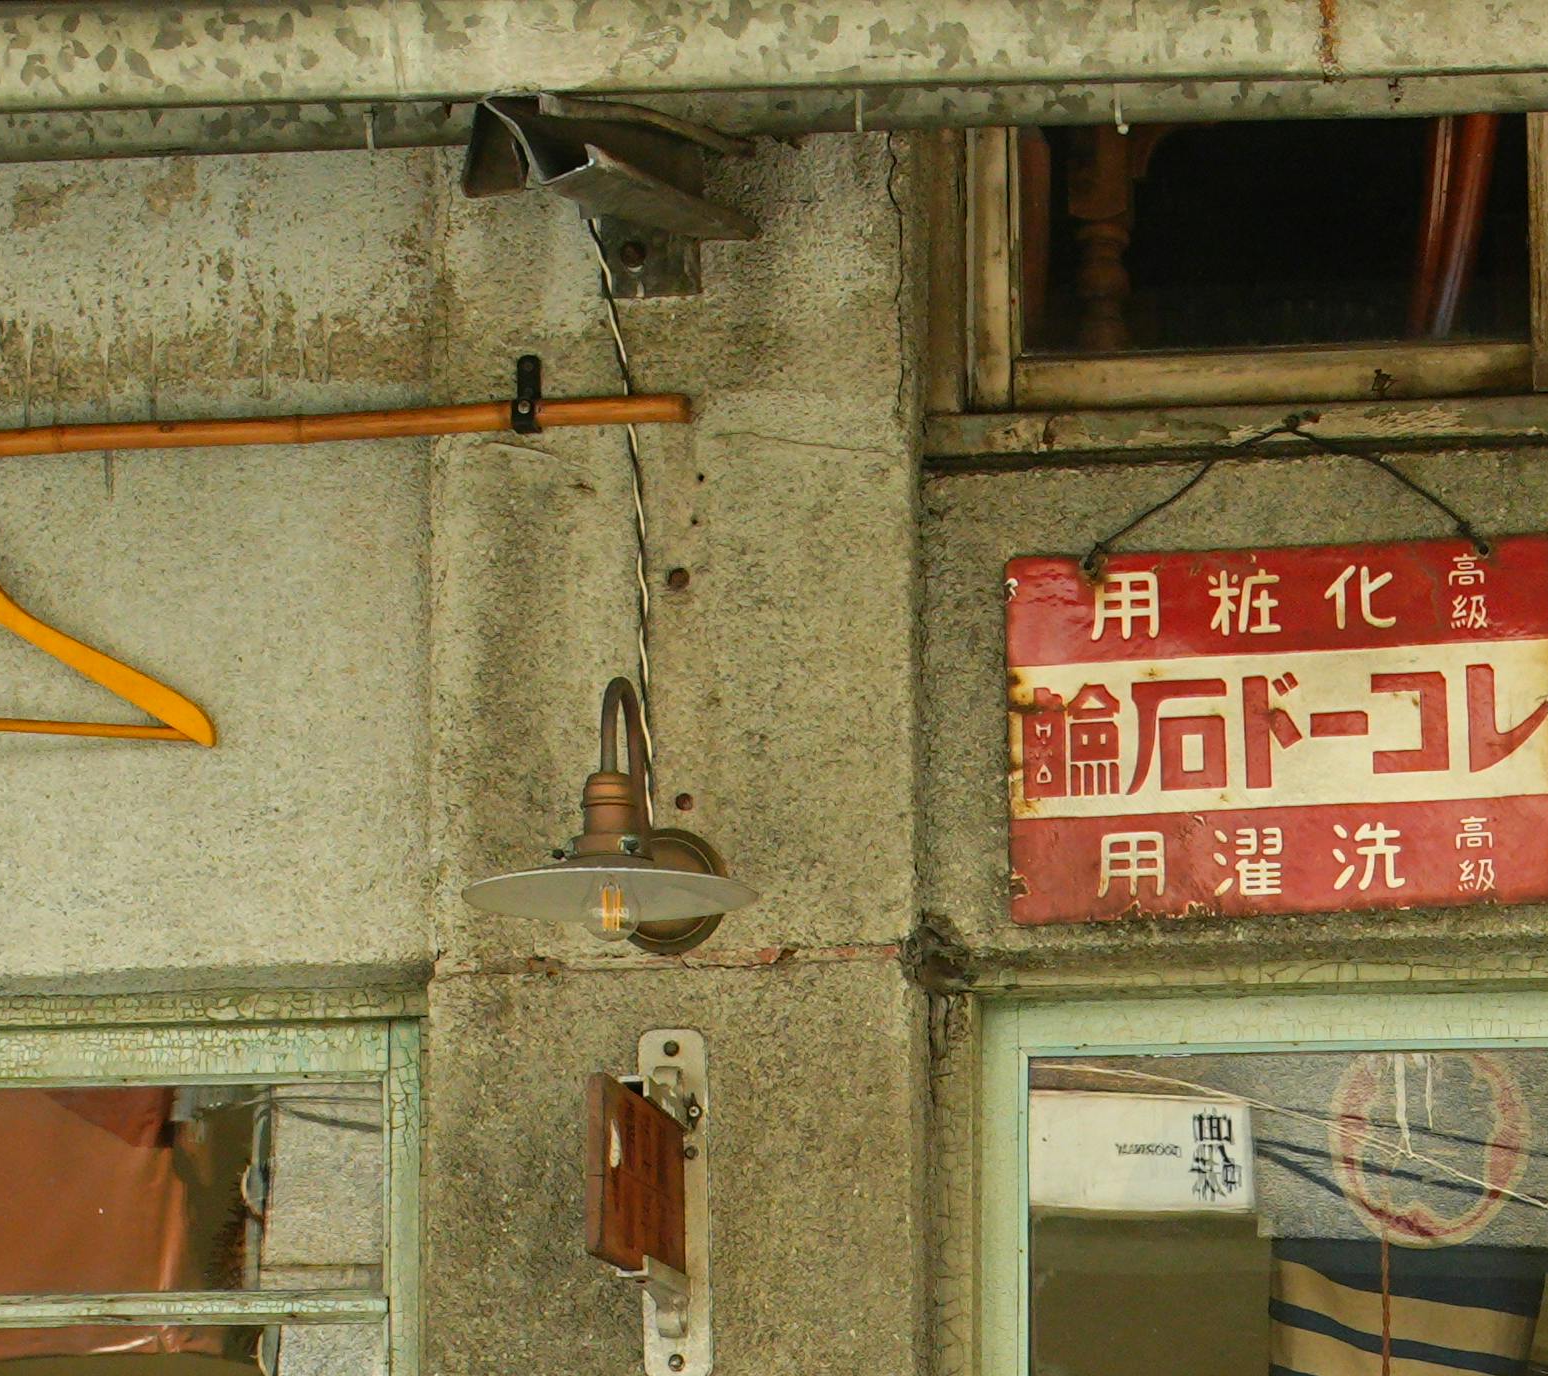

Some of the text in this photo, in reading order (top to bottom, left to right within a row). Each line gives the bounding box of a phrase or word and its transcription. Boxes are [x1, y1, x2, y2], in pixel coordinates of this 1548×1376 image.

[1089, 561, 1400, 642] 化粧用
[1448, 552, 1489, 632] 高級
[1097, 825, 1409, 900] 洗濯用
[1455, 815, 1498, 893] 高級
